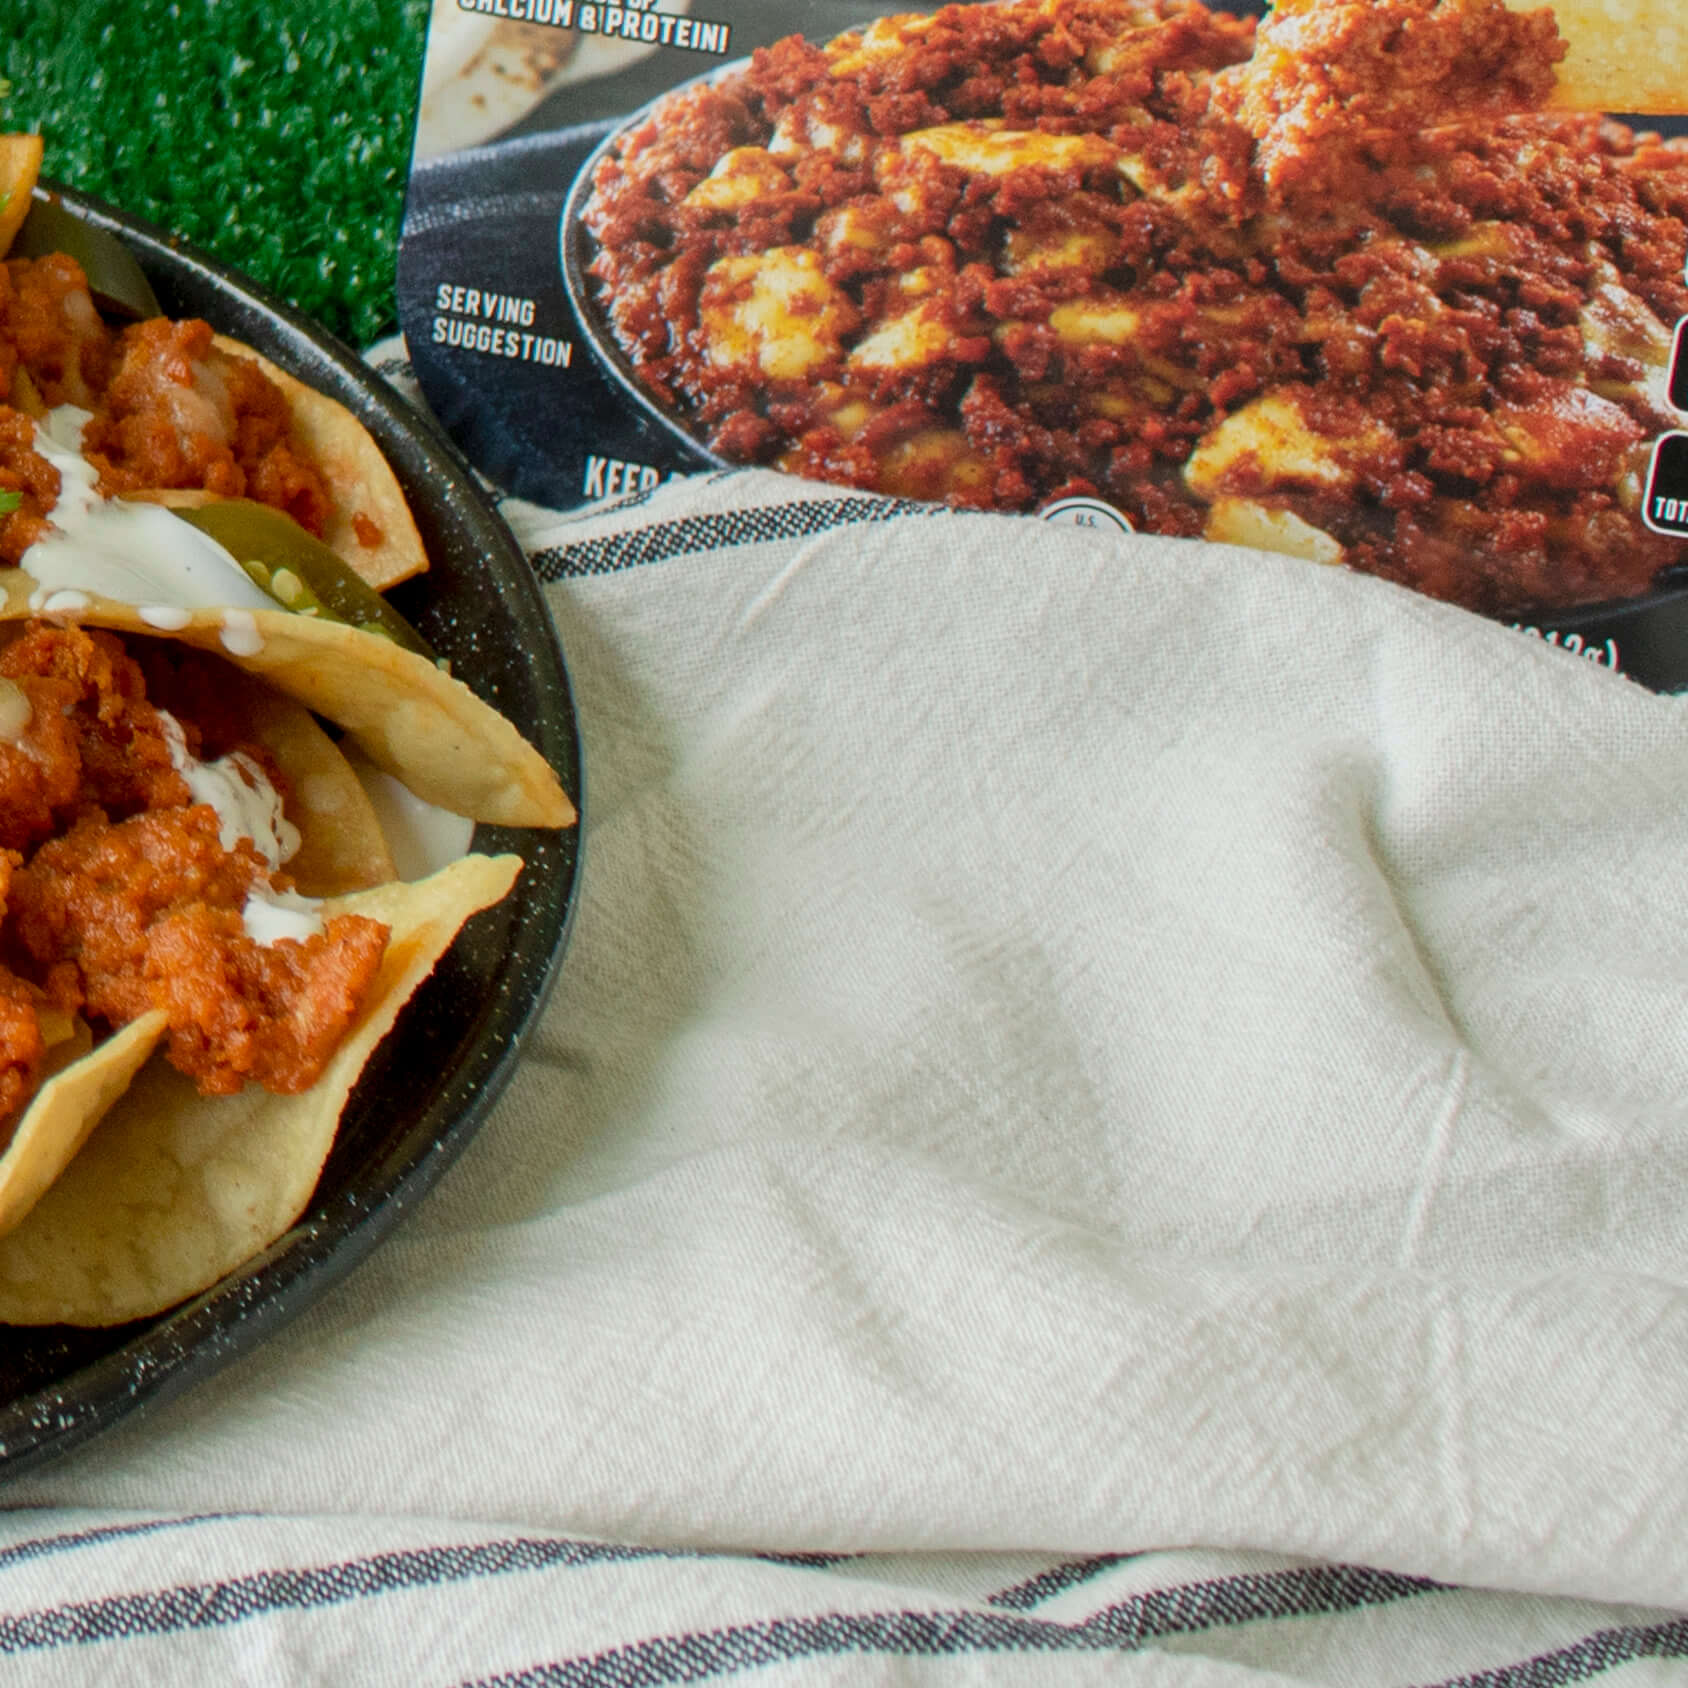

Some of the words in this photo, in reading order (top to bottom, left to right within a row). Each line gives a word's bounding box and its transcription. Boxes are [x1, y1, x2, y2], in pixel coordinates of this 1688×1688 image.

[578, 3, 598, 32] &
[437, 283, 536, 326] SERVING
[433, 317, 573, 369] SUGGESTION
[1655, 497, 1688, 522] TOT
